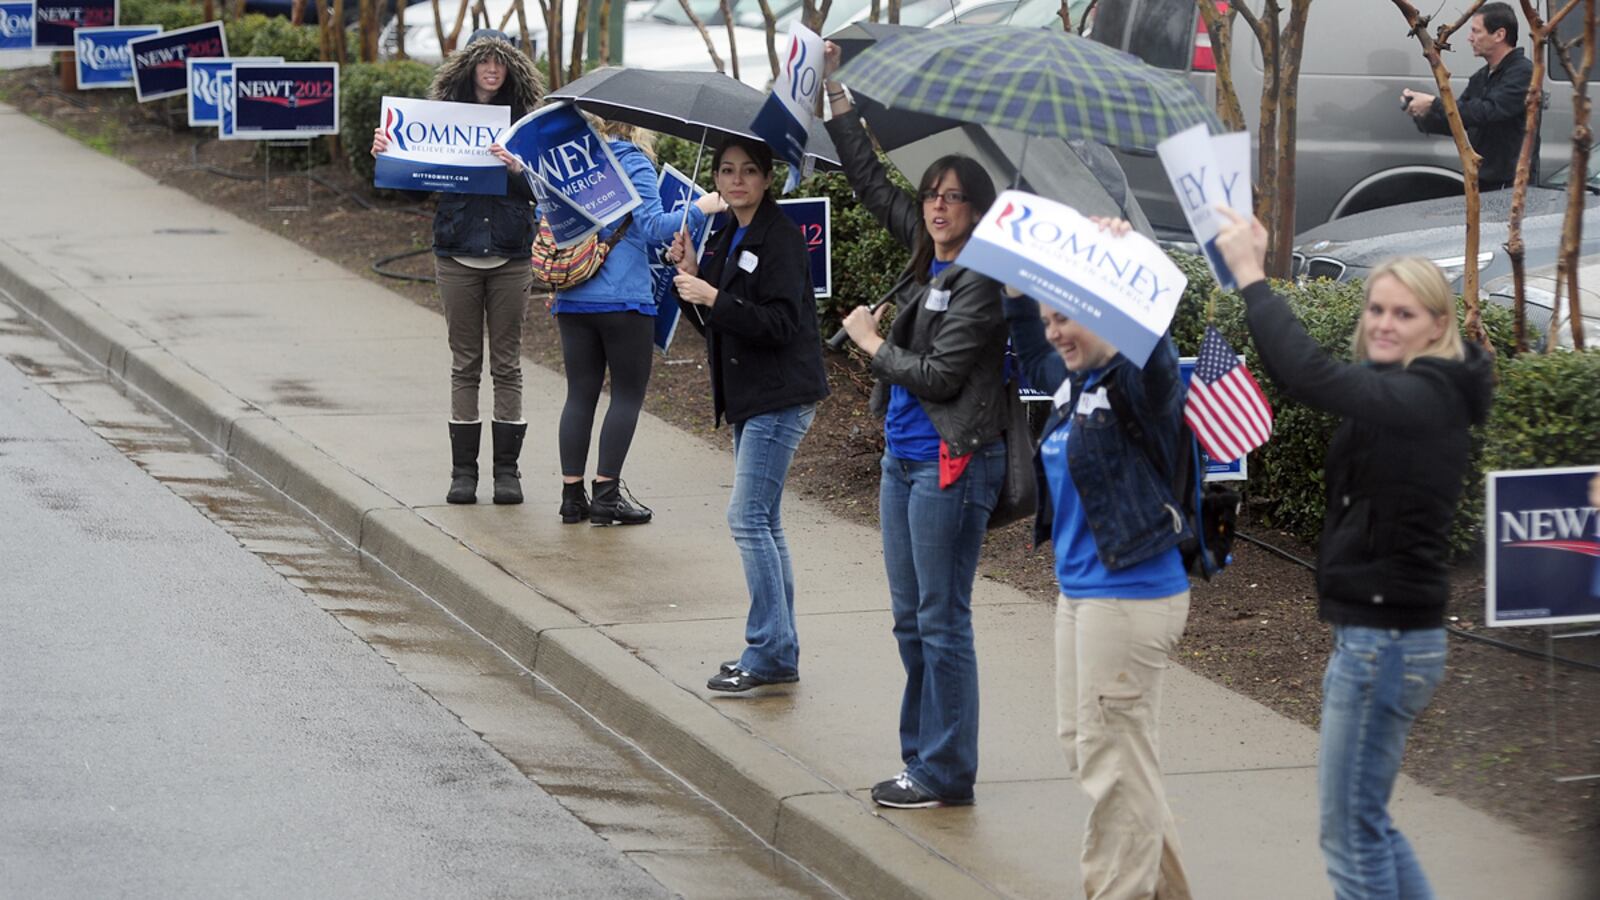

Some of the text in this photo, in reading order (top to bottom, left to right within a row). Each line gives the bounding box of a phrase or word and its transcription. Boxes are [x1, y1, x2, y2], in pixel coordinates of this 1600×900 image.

[385, 107, 502, 151] ROMNEY
[411, 145, 495, 157] BELIEVE IN AMERIC
[560, 171, 607, 196] MERICA
[995, 202, 1170, 303] ROMNEY
